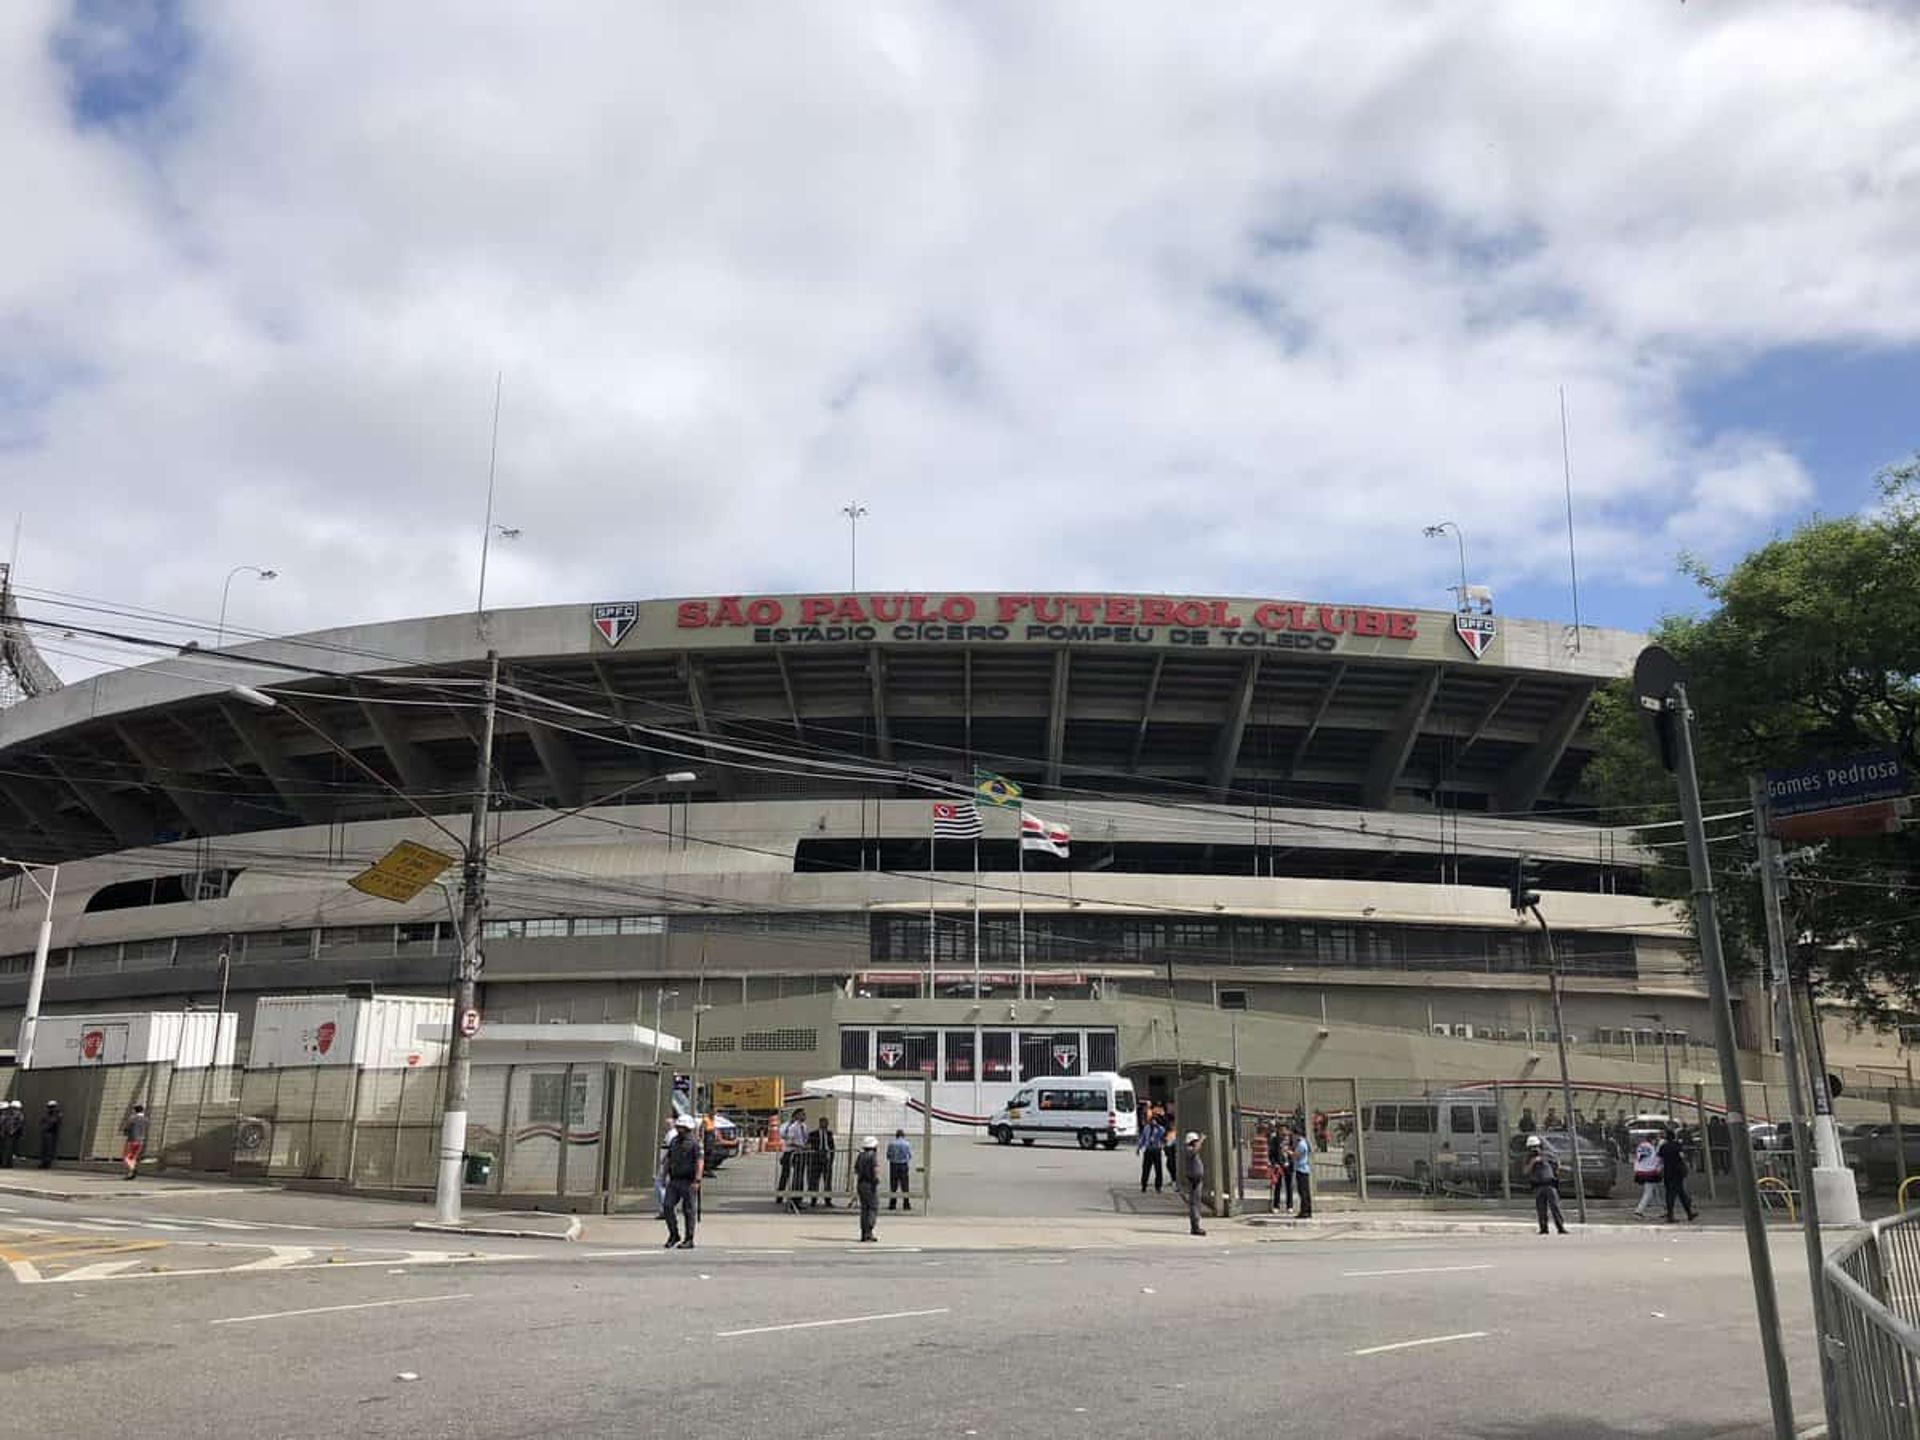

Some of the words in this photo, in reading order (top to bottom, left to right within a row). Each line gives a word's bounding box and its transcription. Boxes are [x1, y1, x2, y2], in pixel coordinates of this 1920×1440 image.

[678, 596, 783, 628] SÃO
[801, 595, 976, 625] PAULO
[997, 594, 1242, 628] FUTEBOL
[1254, 602, 1418, 640] CLUBE
[893, 622, 1009, 641] CÍCERO
[1026, 625, 1154, 642] POMPEU
[1170, 629, 1209, 645] DE
[1219, 630, 1336, 651] TOLEDO
[1767, 774, 1820, 798] Gomes
[1826, 760, 1899, 787] Pedrosa
